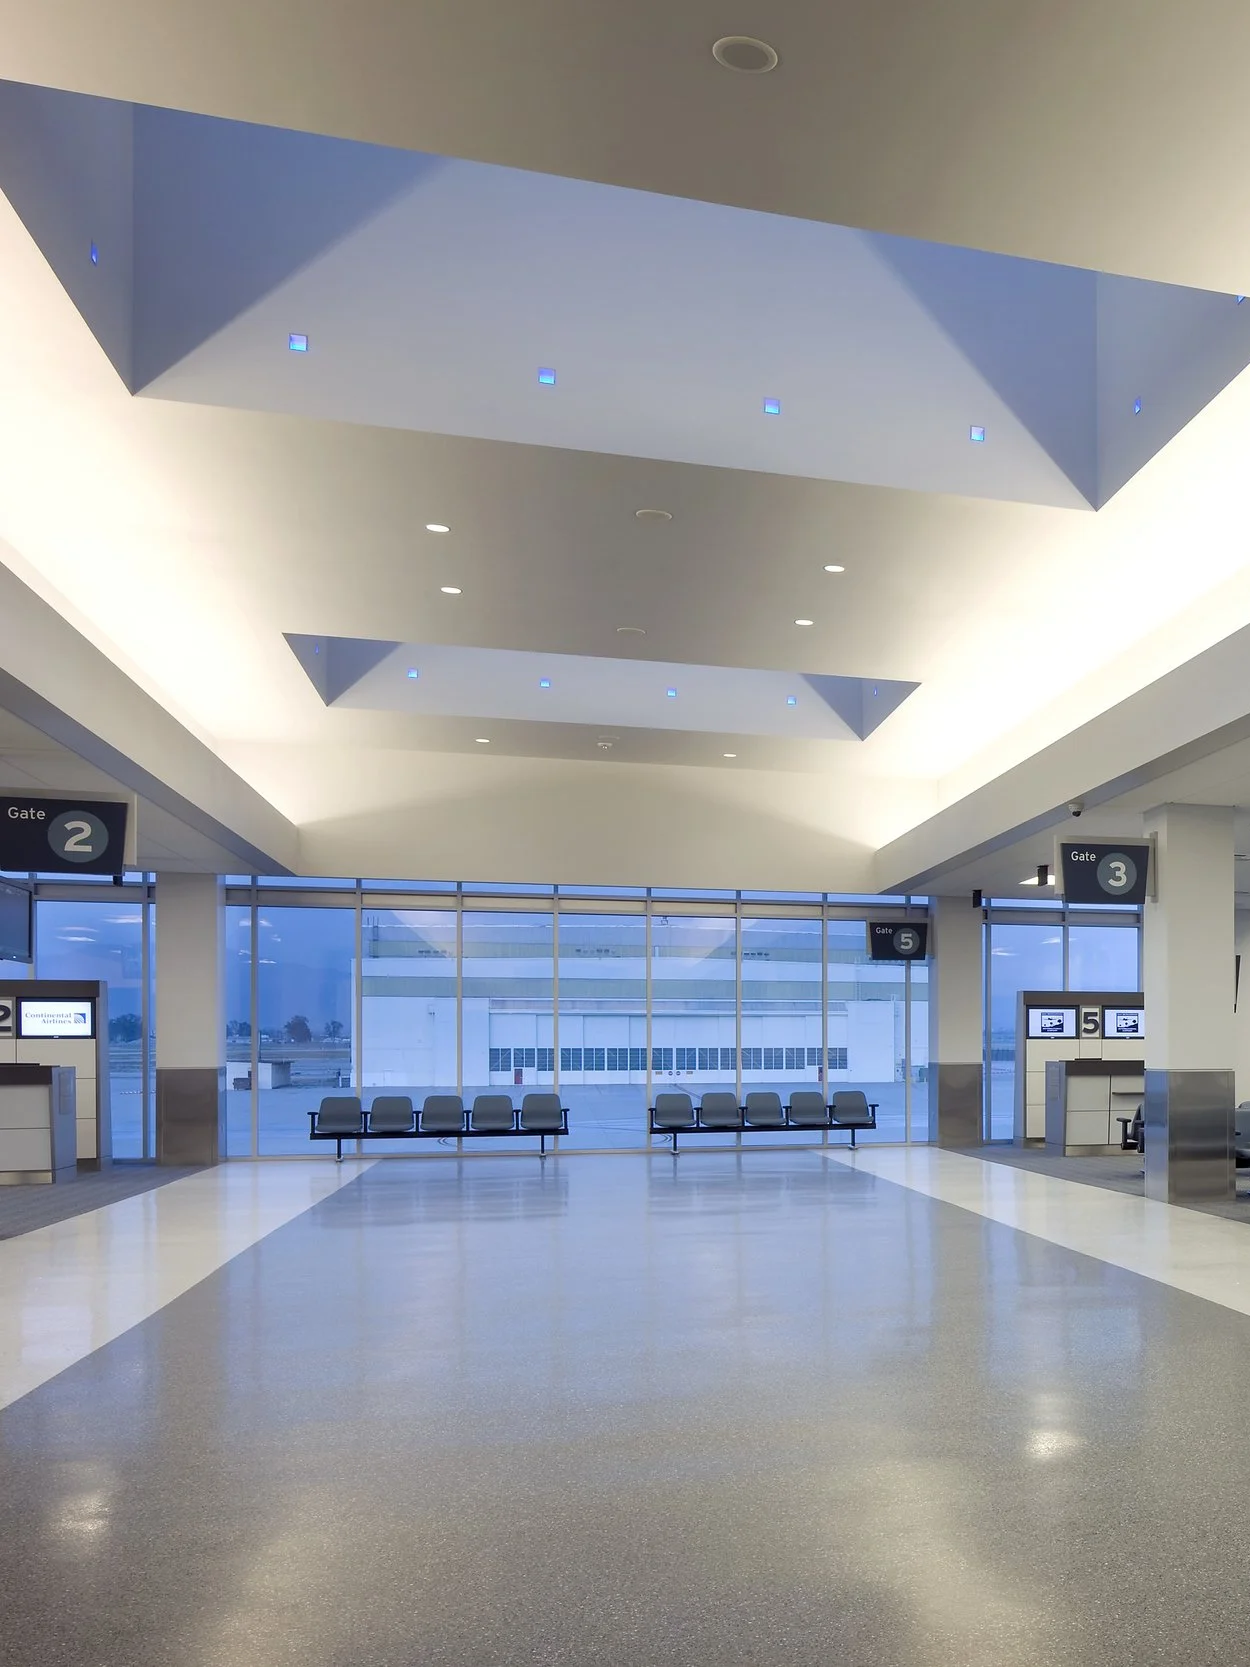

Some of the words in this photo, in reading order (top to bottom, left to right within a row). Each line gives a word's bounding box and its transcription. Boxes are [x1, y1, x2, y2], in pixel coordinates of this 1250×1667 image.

[7, 806, 46, 820] Gate
[63, 820, 92, 852] 2
[1071, 851, 1097, 861] Gate
[1108, 861, 1127, 887] 3
[900, 933, 914, 950] 5
[1082, 1011, 1100, 1034] 5
